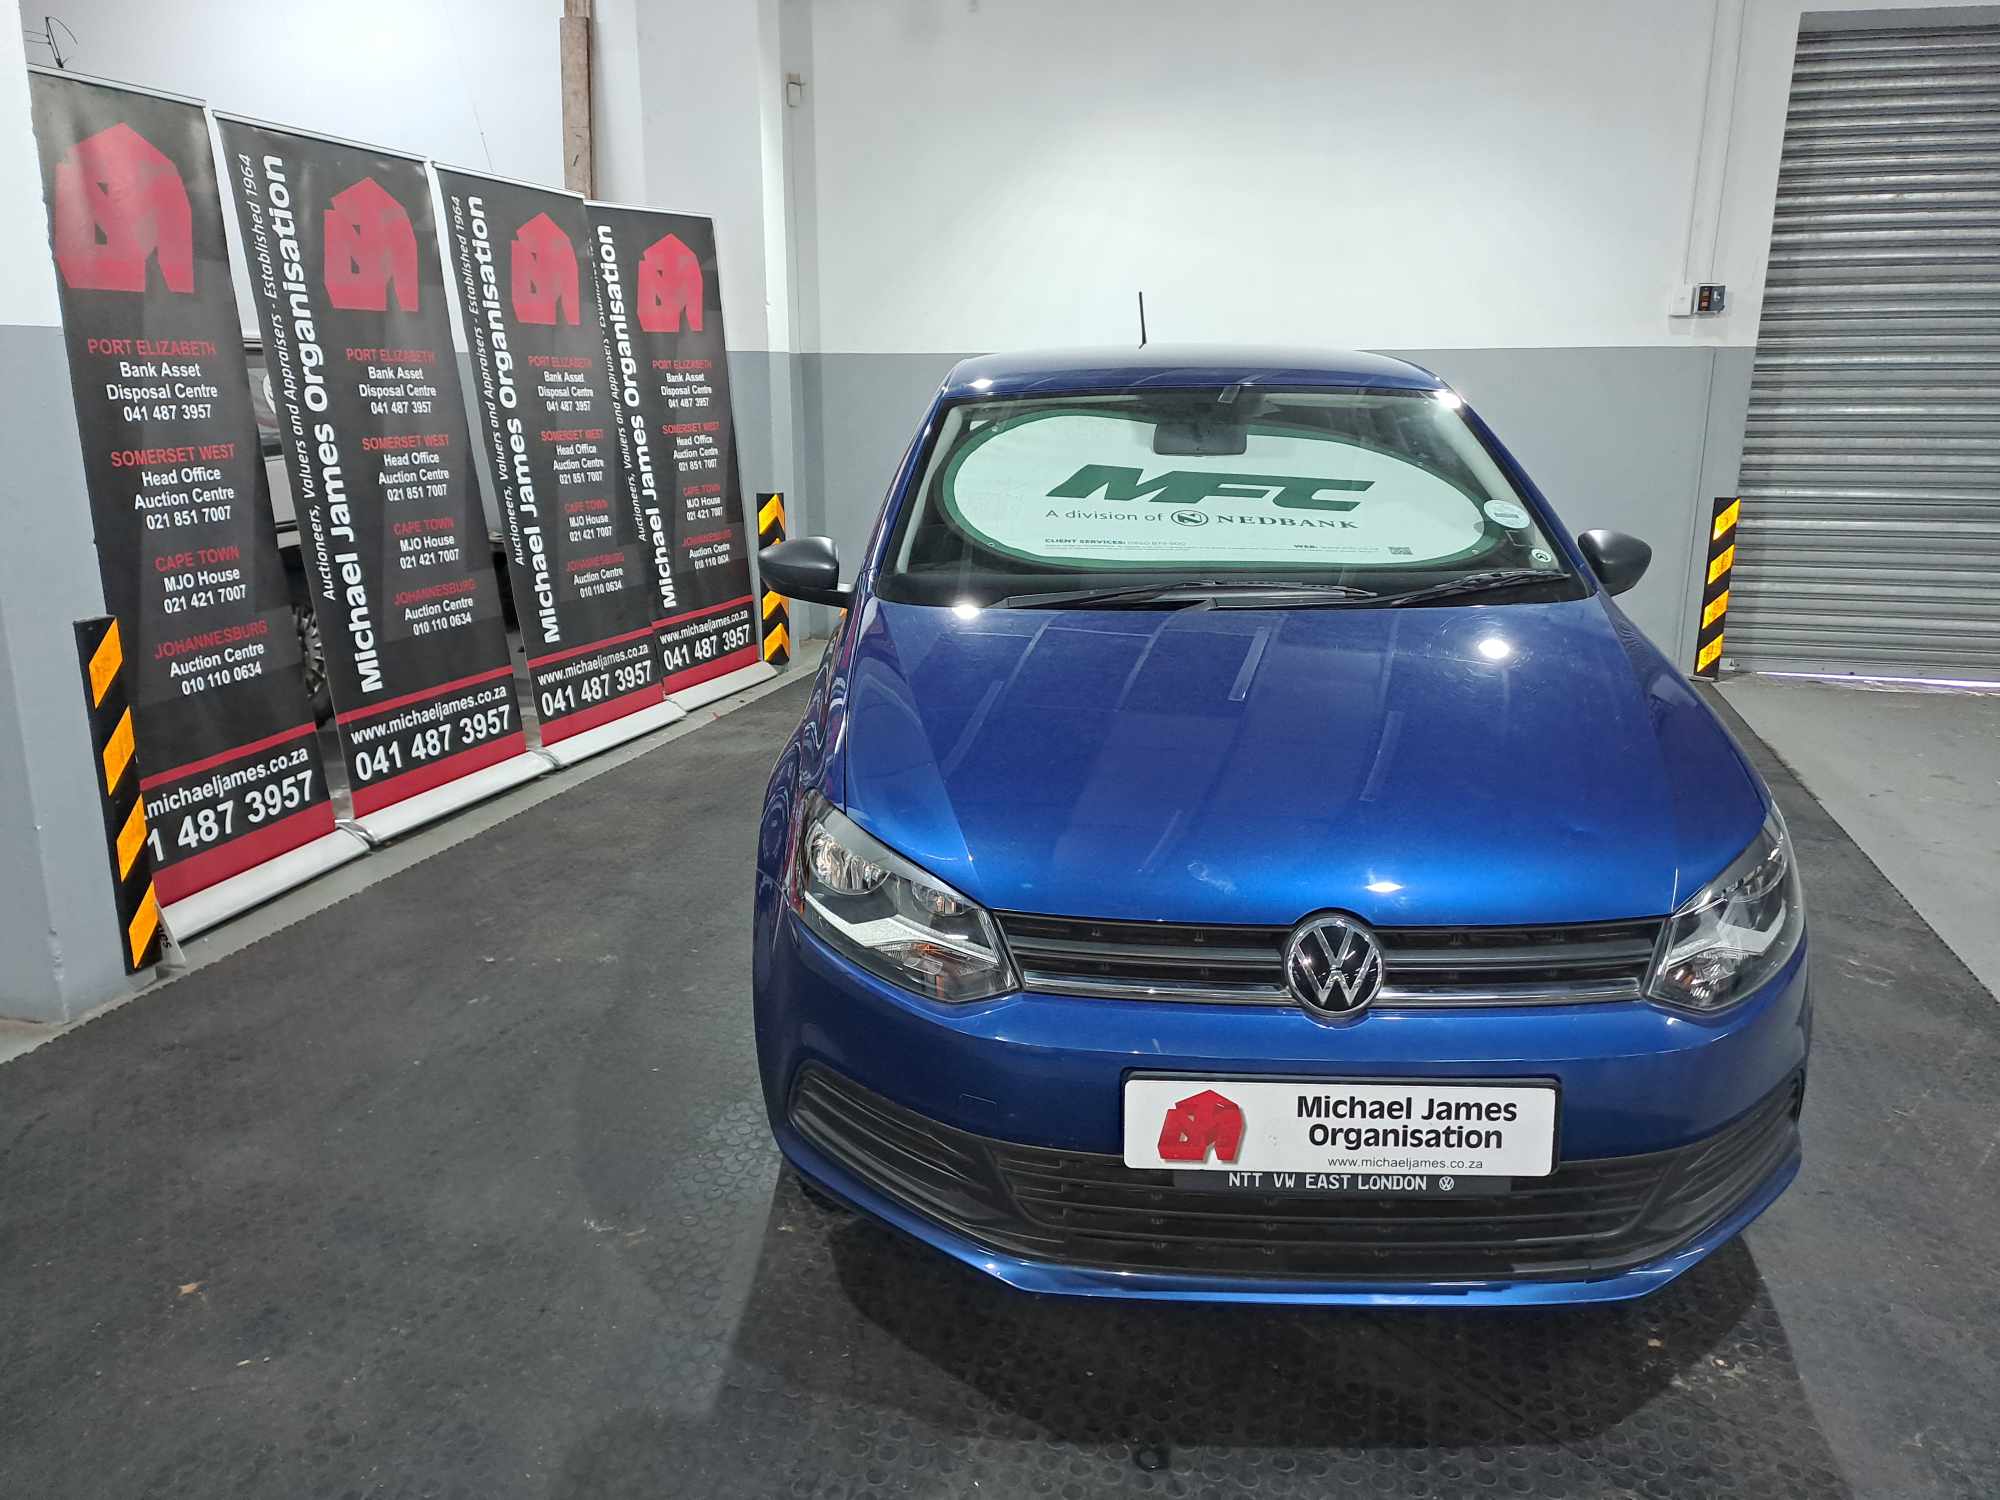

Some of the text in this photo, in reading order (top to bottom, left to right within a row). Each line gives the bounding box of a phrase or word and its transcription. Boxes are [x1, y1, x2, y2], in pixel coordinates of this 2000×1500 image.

[451, 195, 465, 231] 1964
[456, 232, 479, 315] Established
[597, 224, 640, 408] Organisation
[87, 338, 217, 357] PORT ELIZABETH
[345, 347, 376, 361] PORT
[119, 361, 202, 378] Bank Asset
[367, 366, 424, 380] Bank Asset
[473, 326, 495, 400] Appraisers
[238, 153, 336, 602] Auctioneers, Valuers and Appraisers Established 1964
[543, 371, 585, 383] Bank Asset
[685, 372, 705, 382] Asset
[106, 382, 218, 403] Disposal Centre
[358, 383, 437, 399] Disposal Centre
[537, 385, 570, 399] Disposal
[660, 384, 690, 397] Disposal
[123, 403, 212, 422] 041 487 3957
[370, 401, 432, 415] 041 487 3957
[486, 402, 500, 428] and
[546, 400, 560, 412] 041
[263, 155, 383, 694] Michael James Organisation
[468, 195, 561, 644] Michael James Organisation
[361, 434, 421, 451] SOMERSET
[556, 443, 597, 456] Head Office
[111, 443, 236, 468] SOMERSET WEST
[383, 451, 440, 467] Head Office
[493, 430, 509, 482] Valuers
[553, 458, 580, 471] Auction
[630, 414, 657, 501] James
[141, 466, 221, 487] Head Office
[378, 468, 450, 486] Auction Centre
[1045, 463, 1376, 512] MFC
[134, 486, 235, 510] Auction Centre
[386, 484, 447, 502] 021 851 7007
[146, 505, 232, 530] 021 851 7007
[585, 513, 609, 525] House
[1045, 509, 1359, 529] A division of NEDBANK
[399, 535, 455, 552] MJO House
[155, 546, 241, 572] CAPE TOWN
[399, 548, 460, 570] 021 421 7007
[645, 507, 678, 610] Michael
[163, 568, 240, 593] MJO House
[573, 567, 624, 586] Auction Centre
[164, 584, 247, 614] 021 421 7007
[404, 597, 474, 621] Auction Centre
[412, 611, 472, 636] 010 110 0634
[659, 610, 748, 645] www.michaeljames.co.za
[155, 619, 269, 660] JOHANNESBURG
[663, 623, 750, 671] 041 487 3957
[170, 642, 265, 678] Auction Centre
[537, 643, 649, 686] www.michaeljames.co.za
[181, 661, 263, 696] 010 110 0634
[541, 660, 651, 717] 041 487 3957
[350, 686, 507, 745] www.michaeljames.co.za
[355, 704, 511, 781] 041 487 3957
[144, 747, 309, 821] .michaeljames.co.za
[177, 800, 234, 849] 487
[245, 769, 313, 823] 3957
[1296, 1095, 1518, 1122] Michael James
[1308, 1123, 1504, 1150] Organisation
[1327, 1156, 1483, 1171] www.michaeljames.co.za
[1228, 1172, 1263, 1187] NTT
[1273, 1173, 1296, 1188] VW
[1305, 1174, 1350, 1190] EAST
[1357, 1175, 1427, 1191] LONDON
